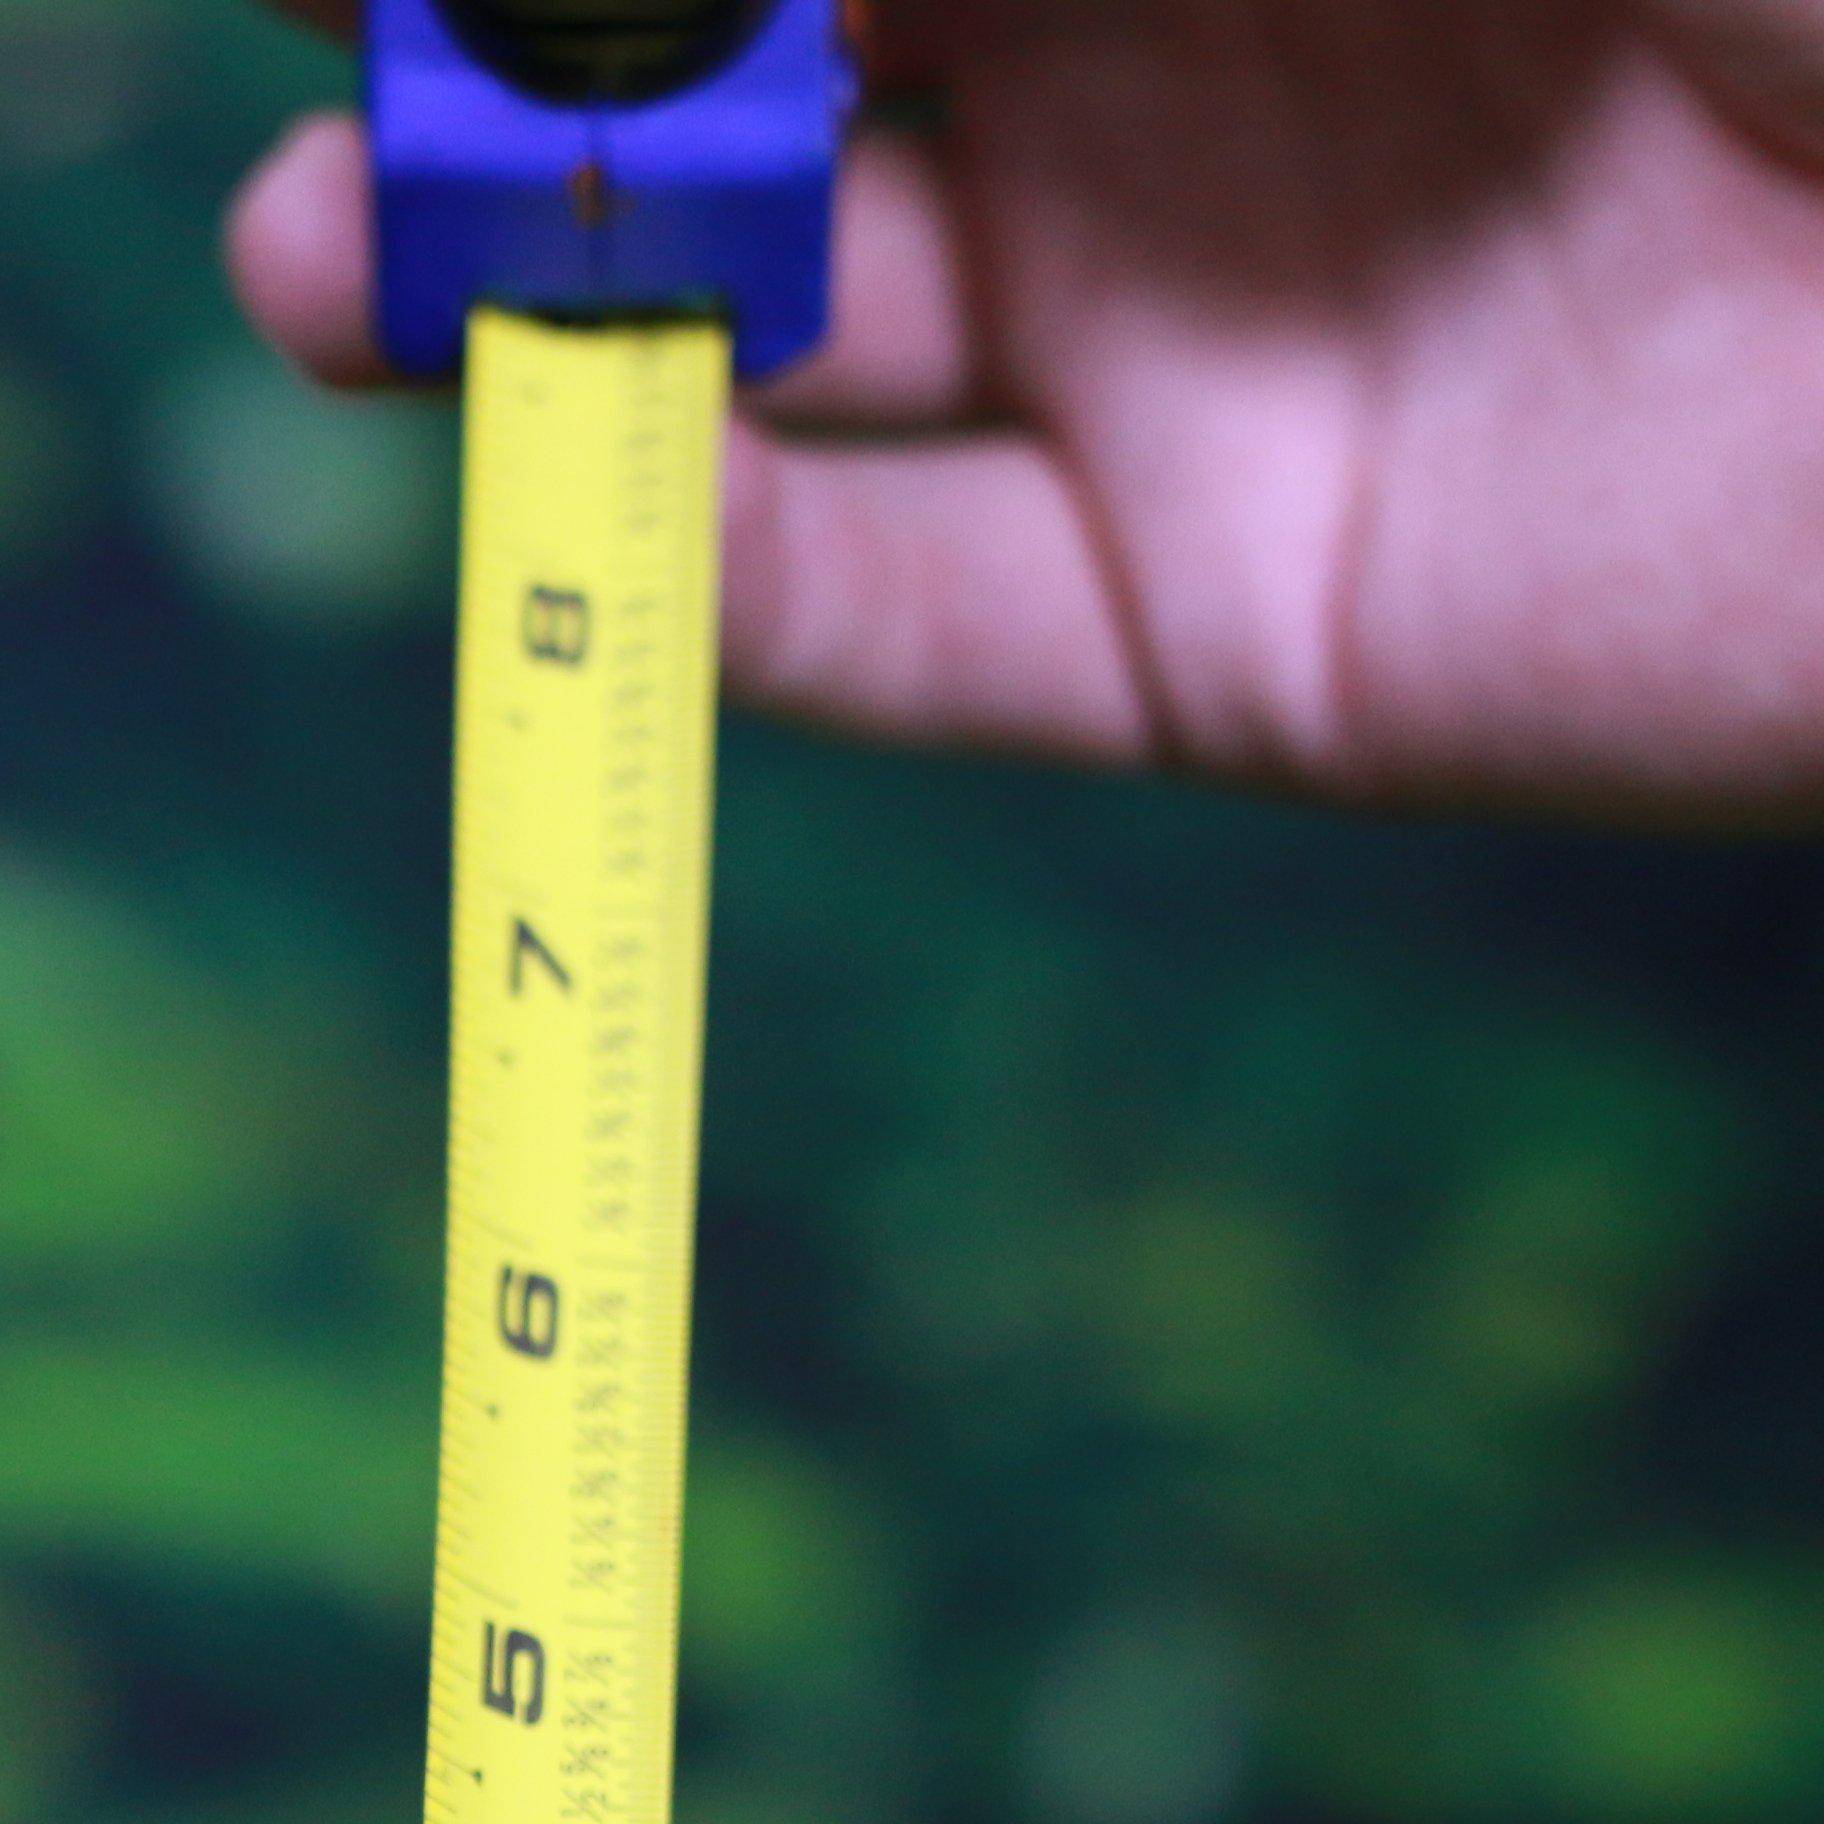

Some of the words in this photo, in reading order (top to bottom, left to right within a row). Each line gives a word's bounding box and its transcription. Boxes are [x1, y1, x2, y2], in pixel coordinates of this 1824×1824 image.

[521, 583, 591, 668] 8
[507, 914, 572, 1000] 7
[497, 1262, 559, 1359] 6
[481, 1618, 545, 1726] 5
